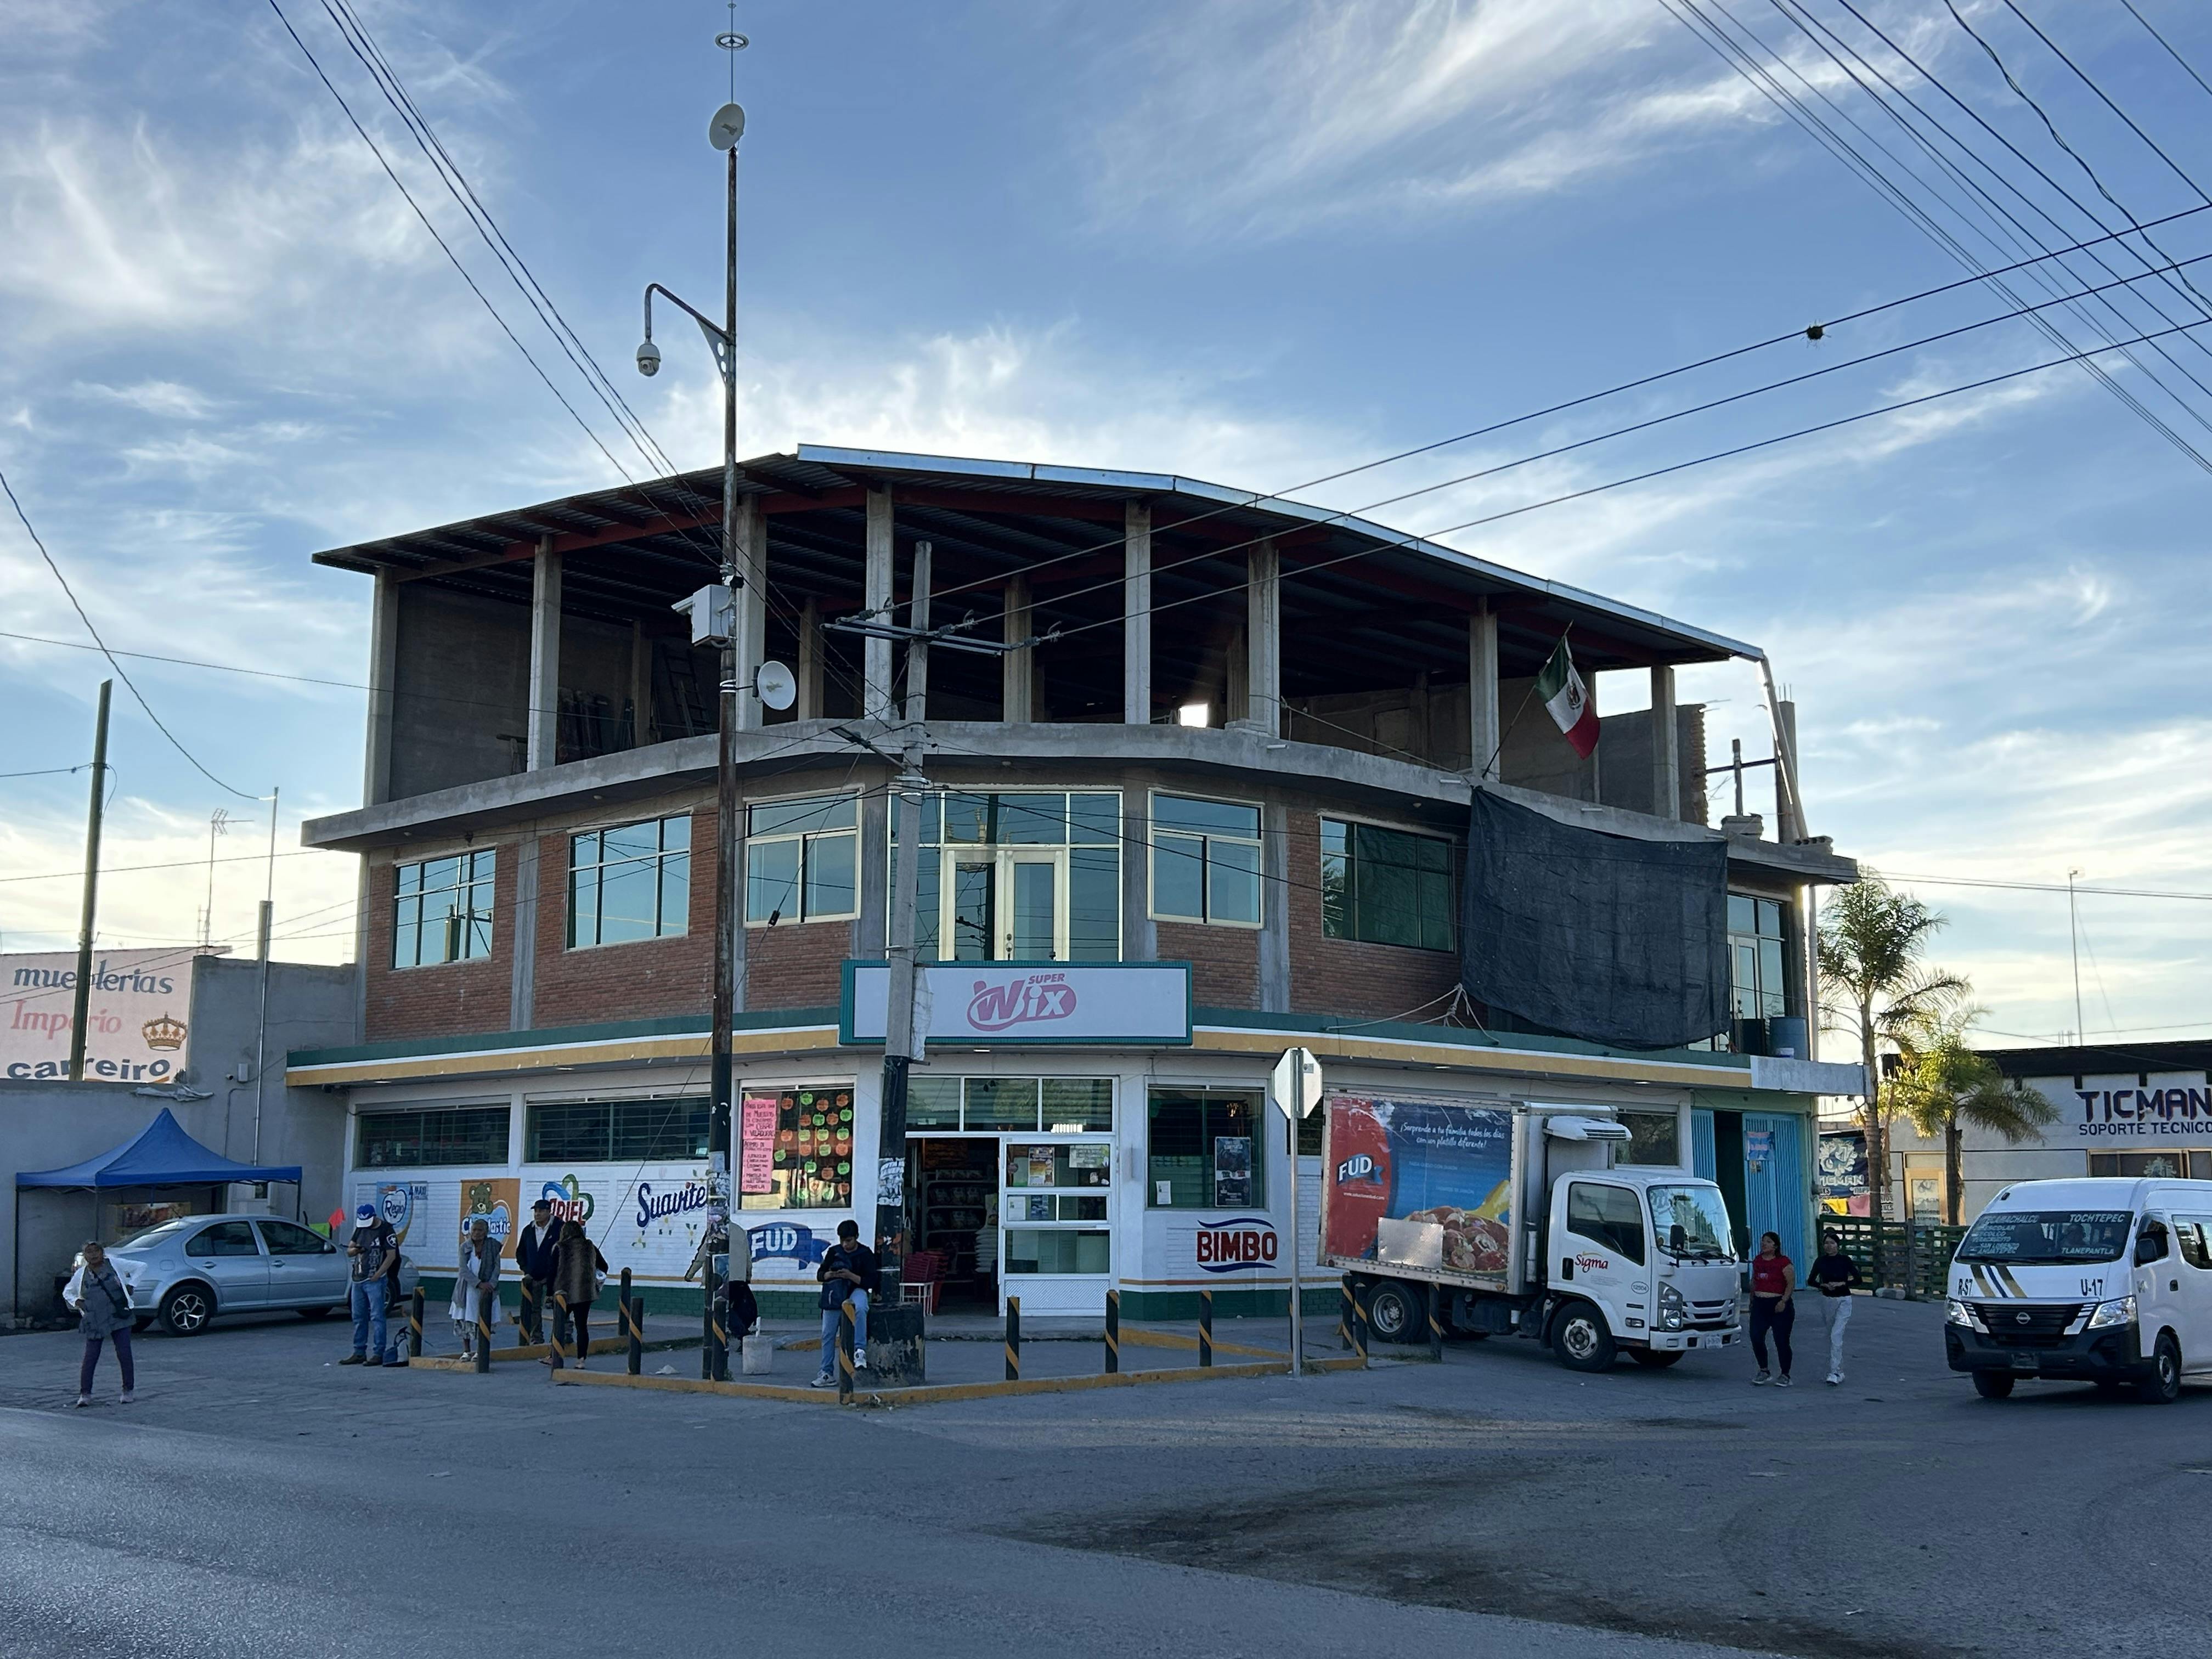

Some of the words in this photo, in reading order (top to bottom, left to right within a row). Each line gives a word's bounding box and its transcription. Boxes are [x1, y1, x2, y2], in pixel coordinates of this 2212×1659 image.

[14, 959, 174, 994] muelerias
[1028, 973, 1065, 984] SUPER
[2075, 1088, 2212, 1122] TICMAN
[2079, 1123, 2146, 1136] SOPORTE
[2151, 1122, 2212, 1135] TECNICO
[1339, 1156, 1373, 1181] FUD
[637, 1182, 708, 1228] Suavite
[2069, 1214, 2125, 1223] TOCHTEPEC
[751, 1227, 797, 1258] FUD
[1197, 1232, 1278, 1262] BIMBO
[2061, 1247, 2115, 1255] TLANEPANTLA
[1575, 1254, 1609, 1273] Sigma
[2080, 1279, 2103, 1296] U-17
